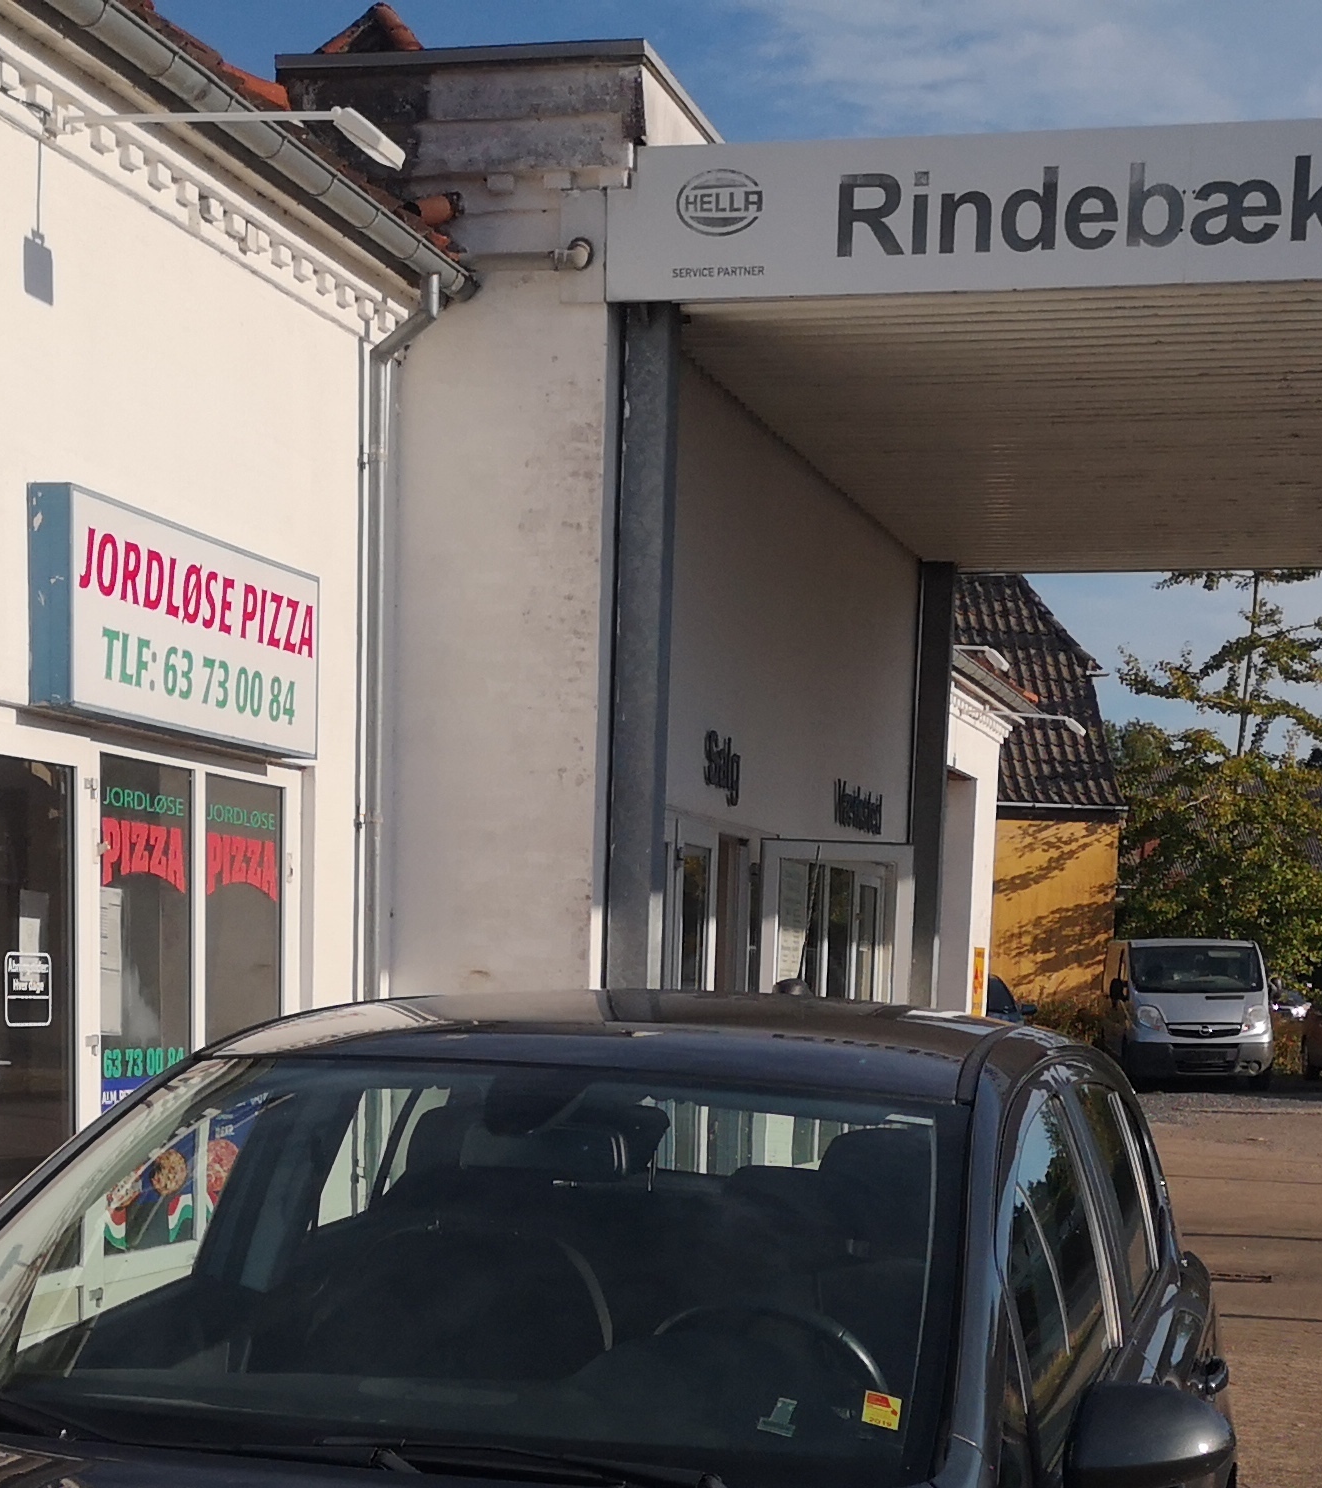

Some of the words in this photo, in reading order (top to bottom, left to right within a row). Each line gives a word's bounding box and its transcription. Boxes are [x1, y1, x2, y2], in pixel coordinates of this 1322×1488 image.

[685, 190, 763, 212] HELLA
[672, 267, 714, 278] SERVICE
[718, 266, 765, 276] PARTNER
[79, 526, 235, 635] JORDLØSE
[240, 583, 314, 658] PIZZA
[102, 626, 157, 691] TLF:
[163, 646, 193, 700] 63
[202, 656, 229, 709] 73
[235, 667, 263, 717] 00
[269, 676, 295, 725] 84
[103, 786, 184, 816] JORDLØSE
[207, 804, 276, 830] JORDLØSE
[102, 817, 186, 894] PIZZA
[207, 832, 277, 902] PIZZA
[104, 1049, 122, 1079] 63
[125, 1048, 143, 1077] 73
[146, 1047, 164, 1076] 00
